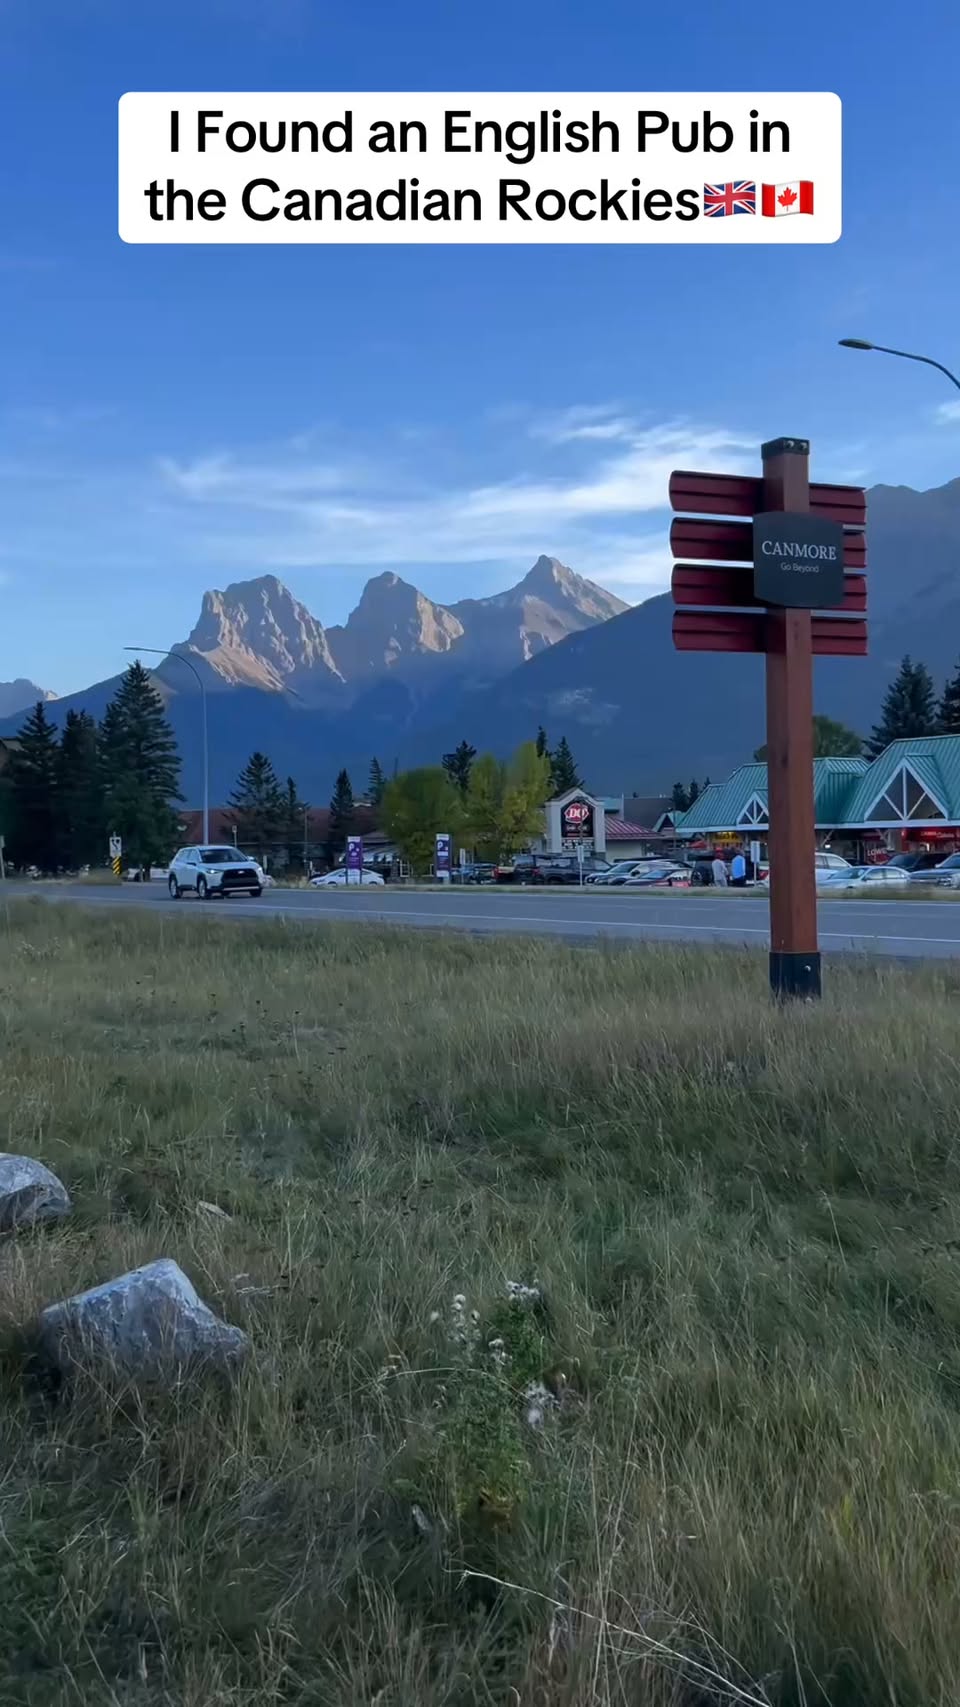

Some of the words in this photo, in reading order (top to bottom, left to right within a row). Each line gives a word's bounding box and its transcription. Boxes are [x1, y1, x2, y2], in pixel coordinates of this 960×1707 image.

[761, 540, 837, 560] CANMORE
[780, 562, 791, 571] Go
[793, 563, 819, 573] Beyond
